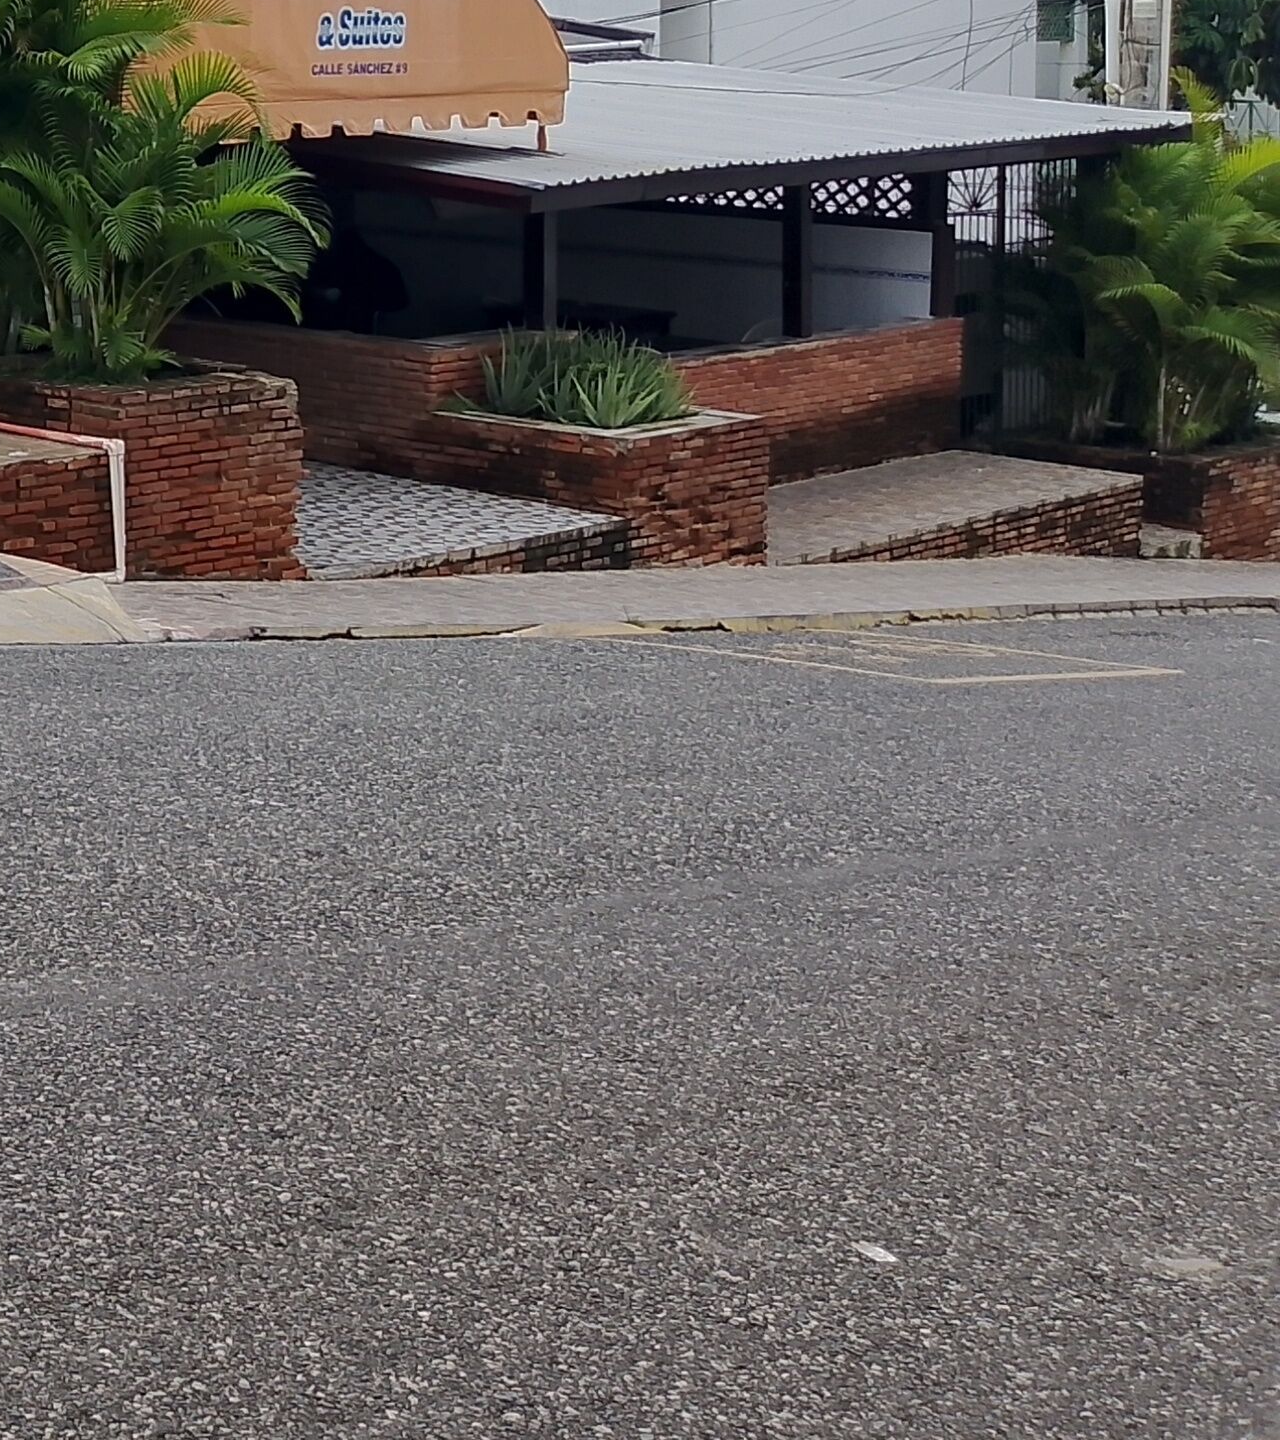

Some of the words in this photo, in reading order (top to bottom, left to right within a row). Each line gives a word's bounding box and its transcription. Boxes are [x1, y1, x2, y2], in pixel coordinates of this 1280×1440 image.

[318, 15, 335, 48] &
[339, 9, 405, 47] Suites
[311, 63, 344, 76] CALLE
